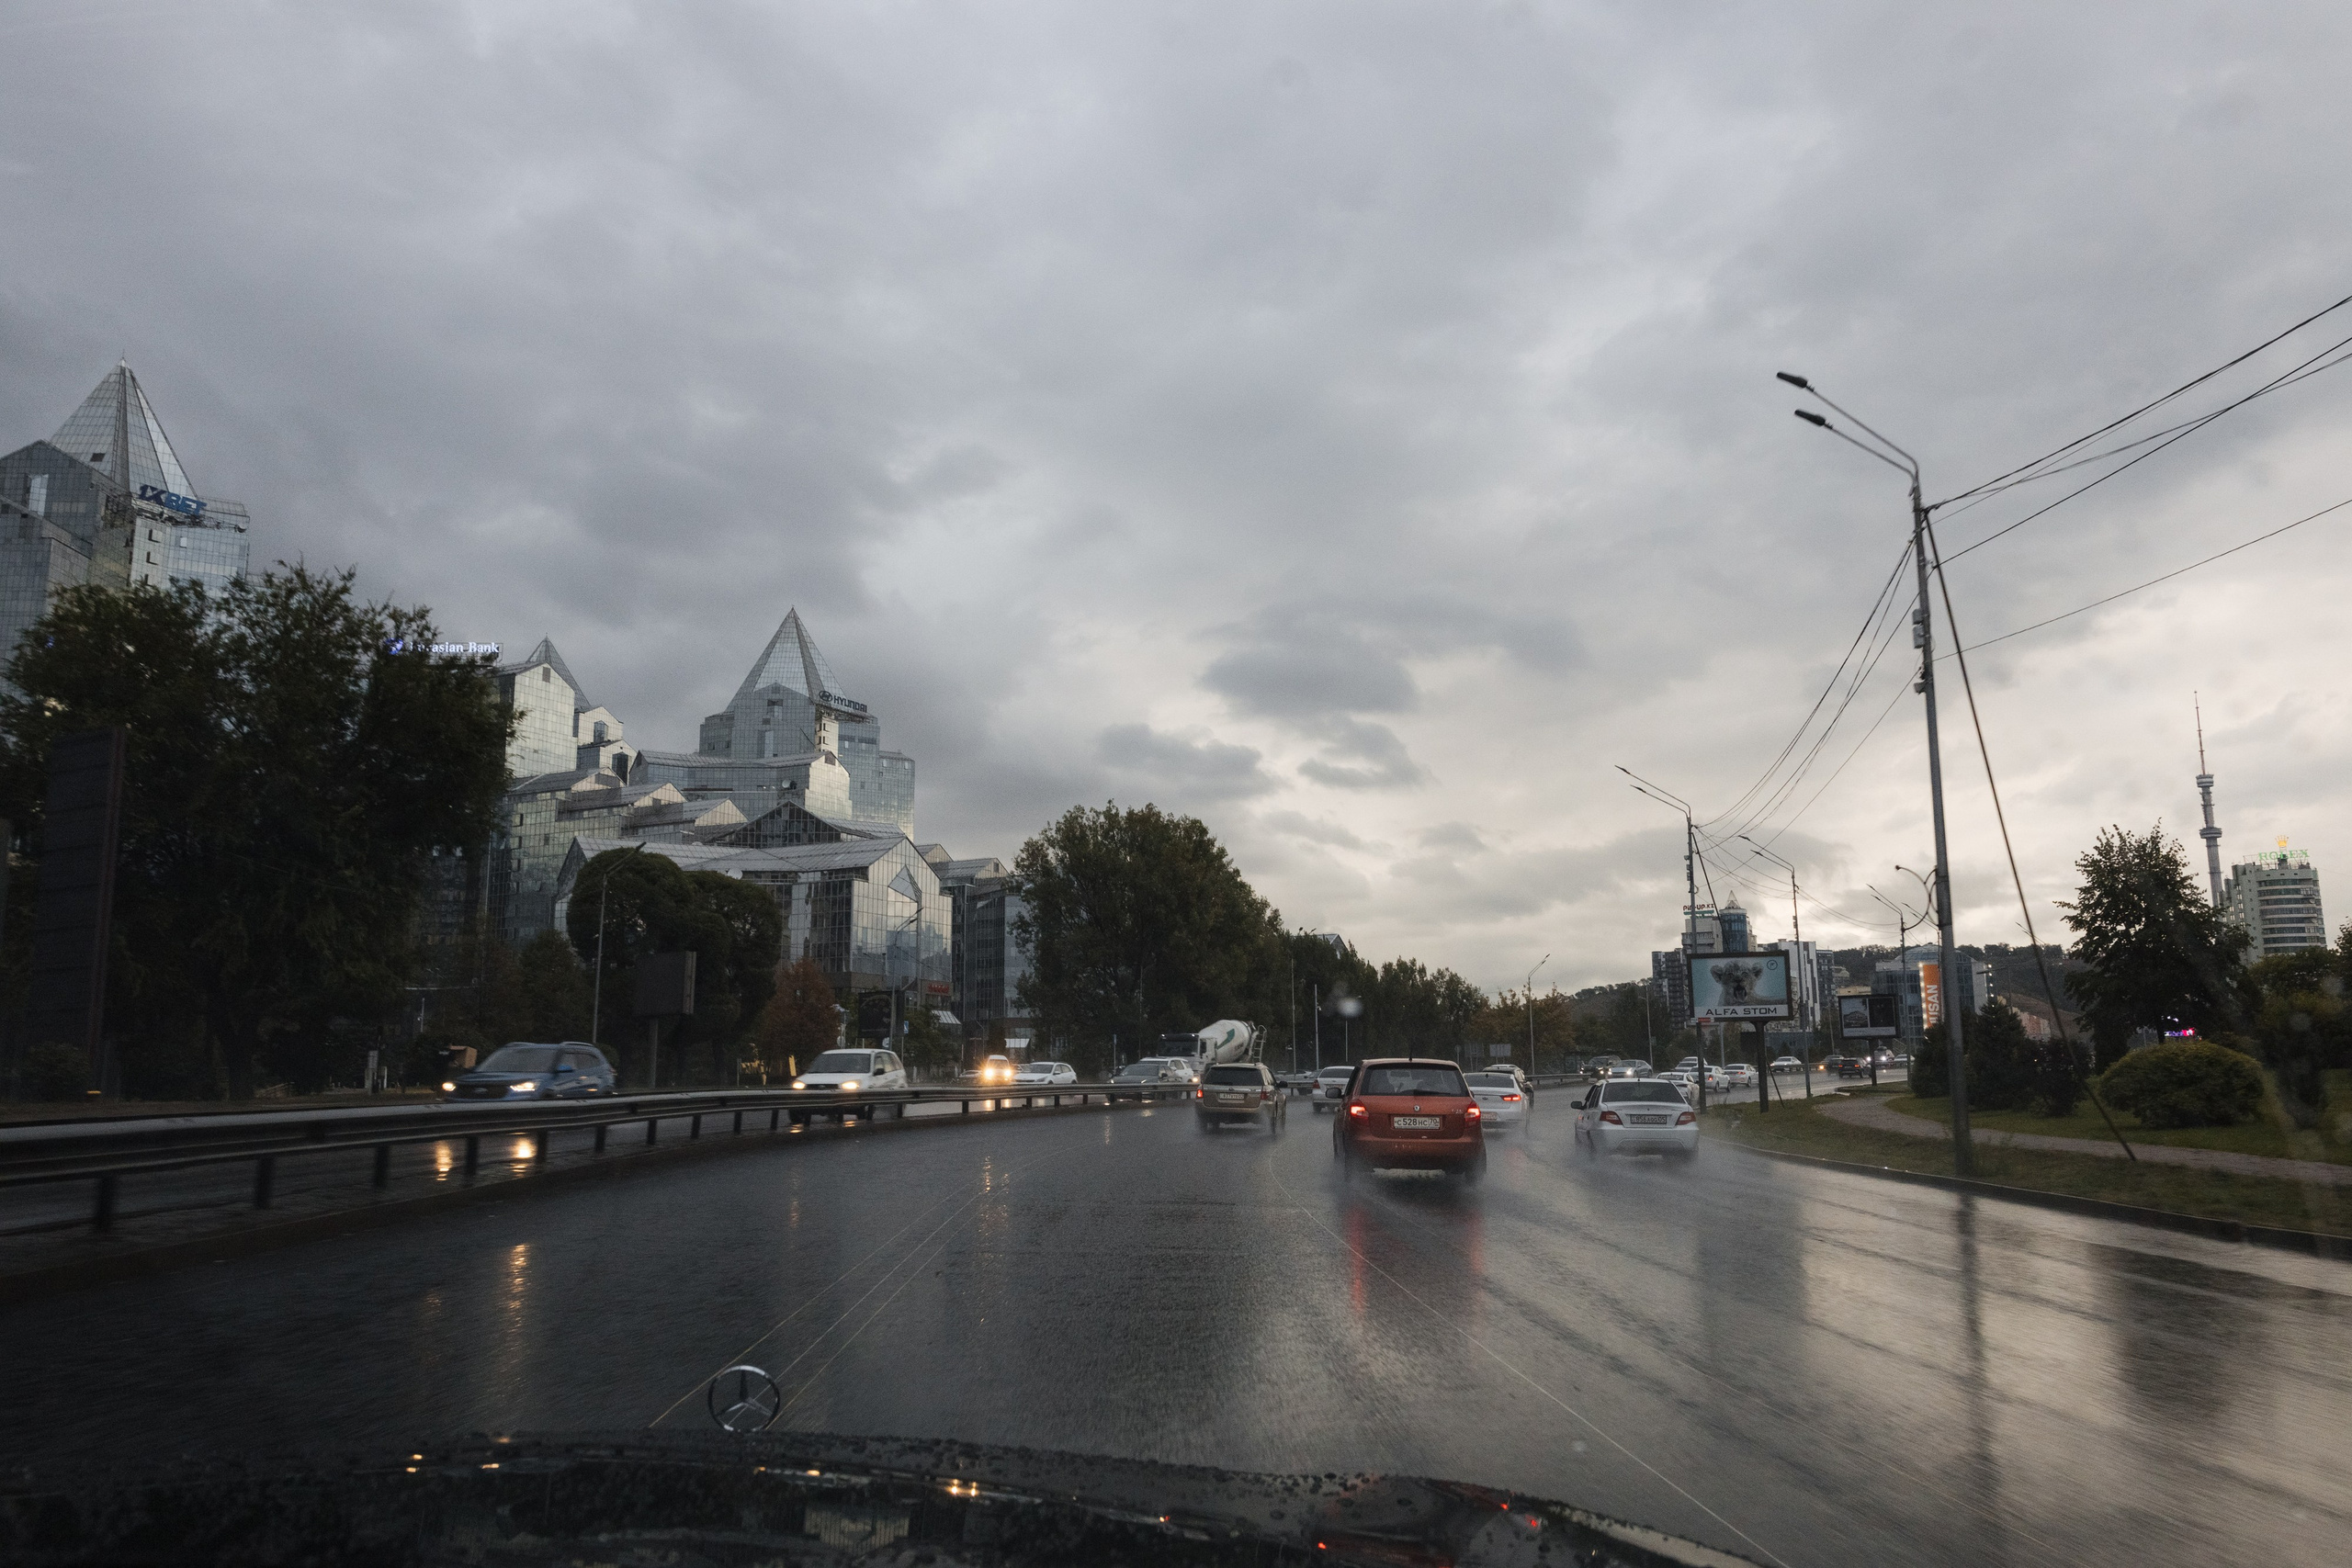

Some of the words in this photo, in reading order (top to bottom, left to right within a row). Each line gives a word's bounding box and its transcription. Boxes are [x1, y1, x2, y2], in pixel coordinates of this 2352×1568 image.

[139, 484, 208, 516] 1XBET
[469, 642, 499, 652] Bank
[833, 694, 867, 713] HYUNDAI
[2258, 849, 2310, 861] ROLEX
[1705, 1008, 1738, 1016] ALFA
[1743, 1007, 1777, 1015] STOM
